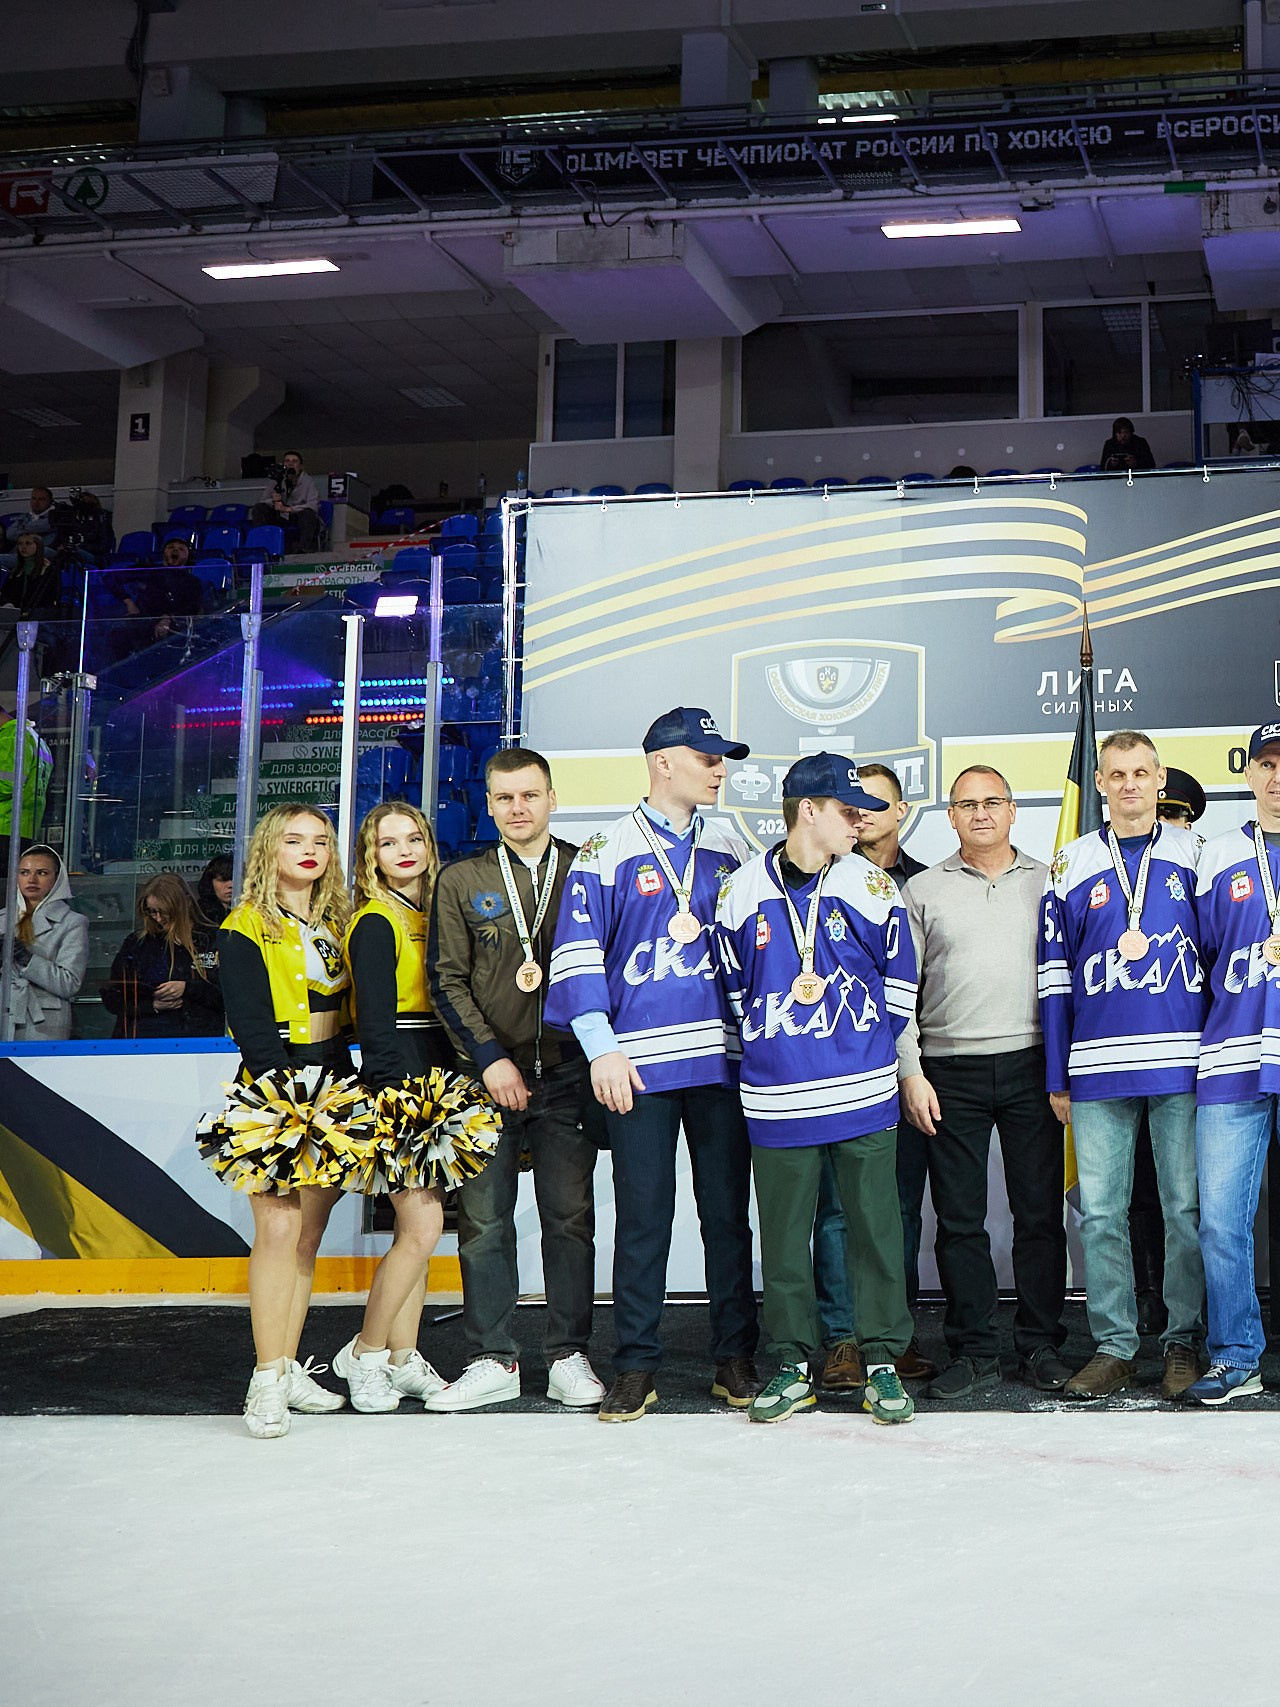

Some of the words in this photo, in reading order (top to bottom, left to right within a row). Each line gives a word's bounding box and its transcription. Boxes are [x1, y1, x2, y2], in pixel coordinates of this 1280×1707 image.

[696, 140, 847, 168] ЧЕМПИОНАТ
[855, 134, 955, 159] РОССИИ
[1007, 124, 1113, 150] ХОККЕЮ
[1036, 667, 1138, 696] ЛИГА
[1041, 698, 1134, 714] СИЛНЫХ
[270, 763, 295, 776] ДЛЯ
[267, 779, 336, 796] SYNERGETIC
[757, 818, 788, 835] 202
